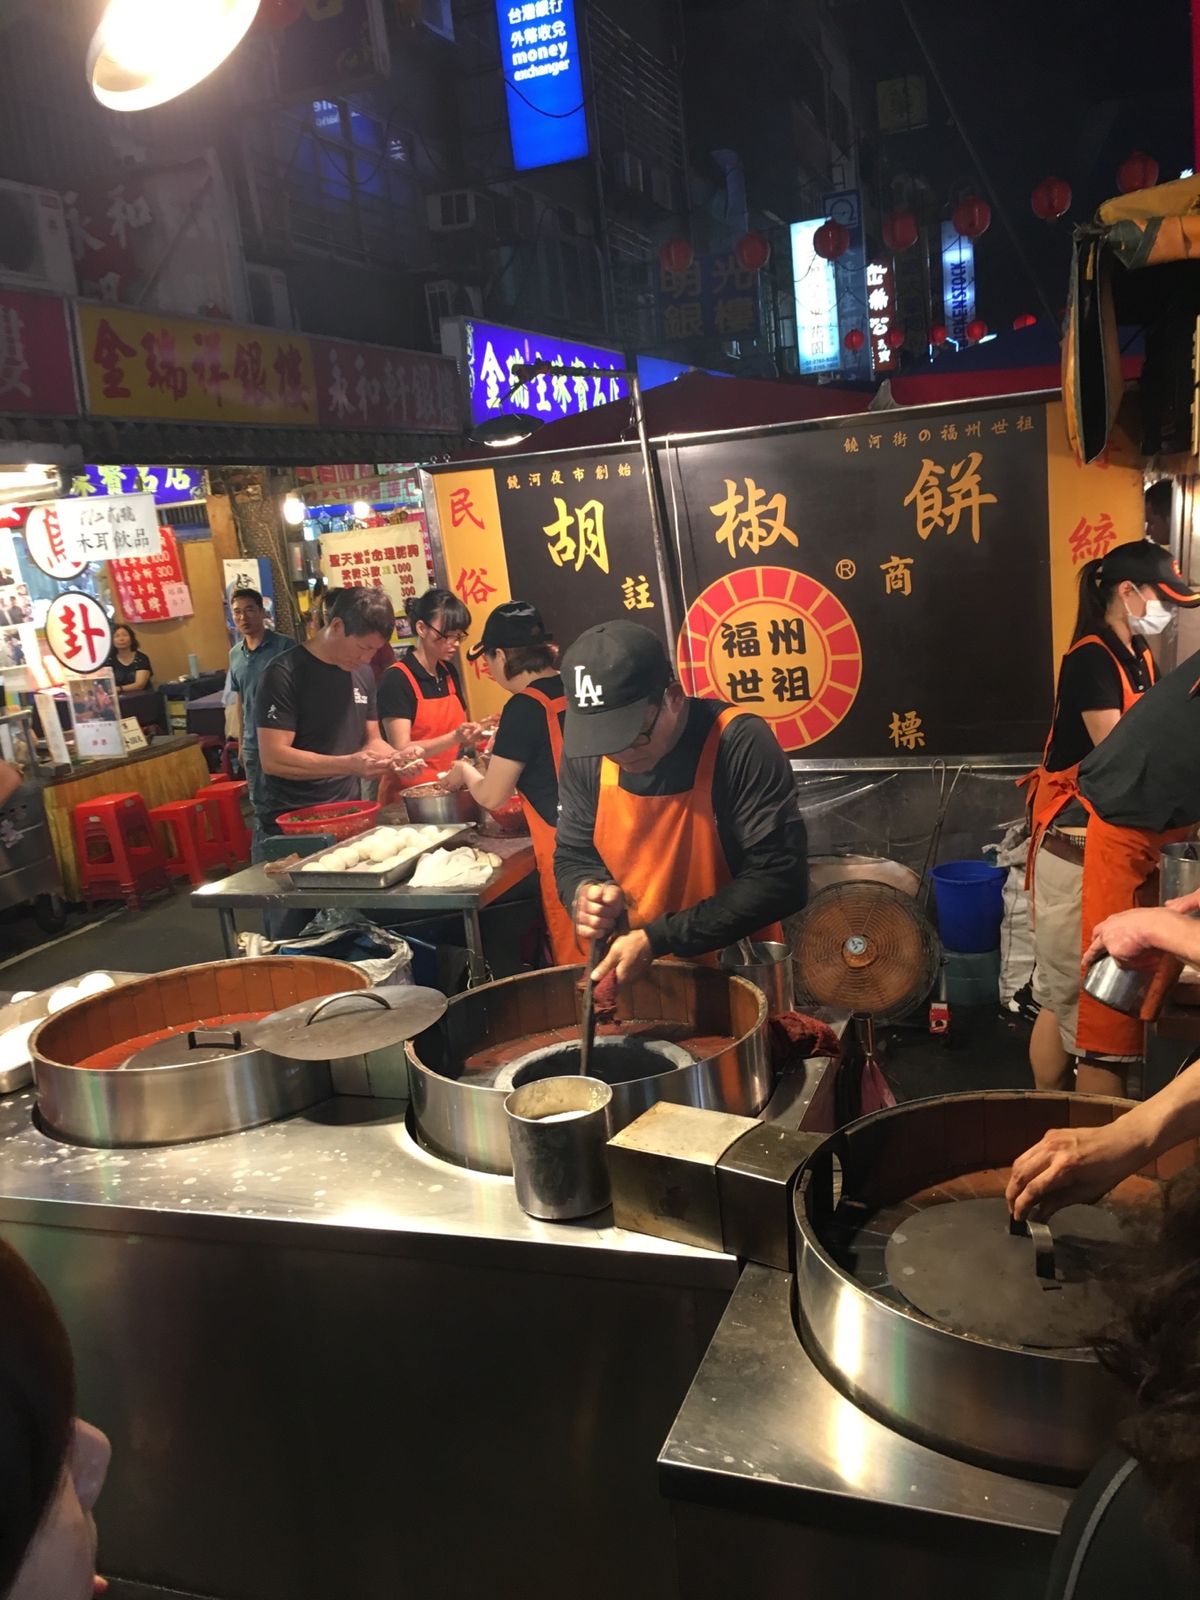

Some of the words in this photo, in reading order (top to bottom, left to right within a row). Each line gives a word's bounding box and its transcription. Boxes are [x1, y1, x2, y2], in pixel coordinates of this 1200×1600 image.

[512, 41, 568, 66] money
[507, 463, 646, 489] 饒河夜市創始
[76, 528, 150, 553] 木耳飲品
[156, 564, 174, 577] 300
[392, 562, 411, 574] 1000
[399, 574, 414, 584] 300
[401, 586, 416, 597] 300
[621, 575, 655, 610] 註
[58, 603, 106, 664] 卦
[721, 617, 807, 659] 福州
[574, 665, 605, 707] LA
[726, 665, 812, 703] 世祖
